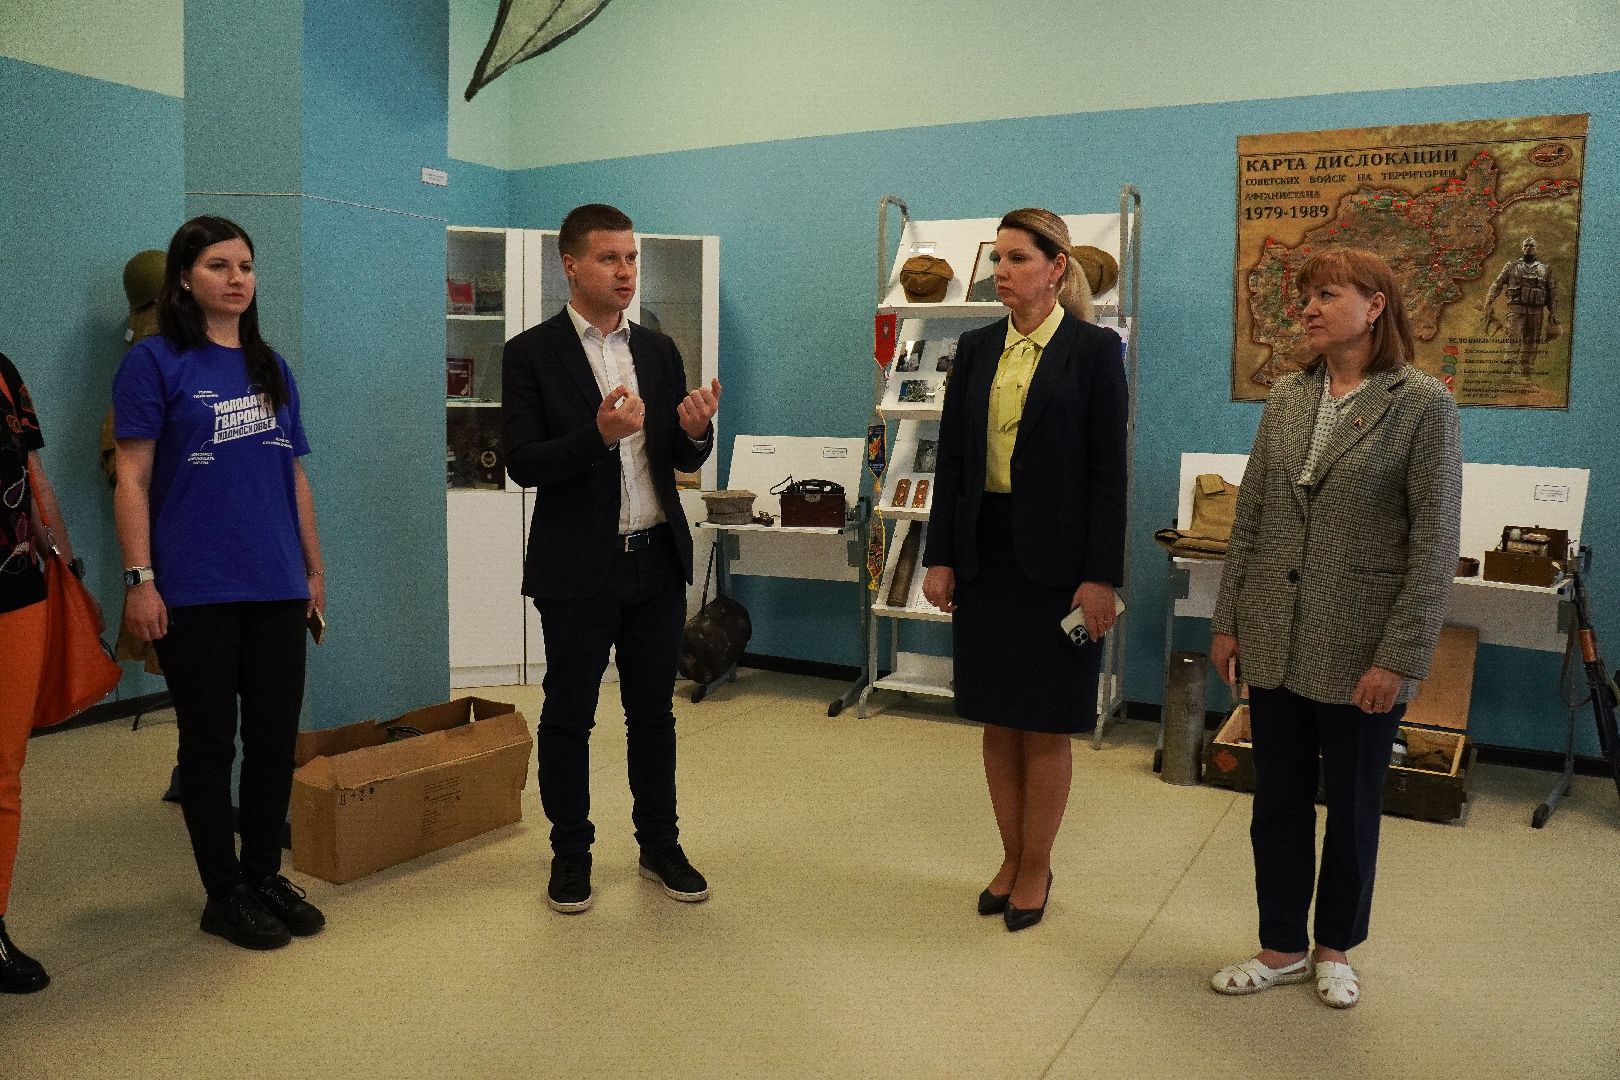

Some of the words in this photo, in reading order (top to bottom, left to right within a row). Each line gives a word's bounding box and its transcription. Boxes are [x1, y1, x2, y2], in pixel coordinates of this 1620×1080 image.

[1246, 156, 1307, 172] КАРТА
[1315, 149, 1458, 171] ДИСЛОКАЦИИ
[1245, 176, 1300, 186] СОВЕТСКИХ
[1309, 173, 1346, 184] ВОЙСК
[1357, 173, 1372, 182] НА
[1380, 169, 1457, 181] ТЕРРИТОРИИ
[1243, 190, 1321, 201] АФГАНИСТАНА
[1244, 205, 1329, 220] 1979-1989
[216, 419, 273, 442] ПОДМОСКОВЬЕ
